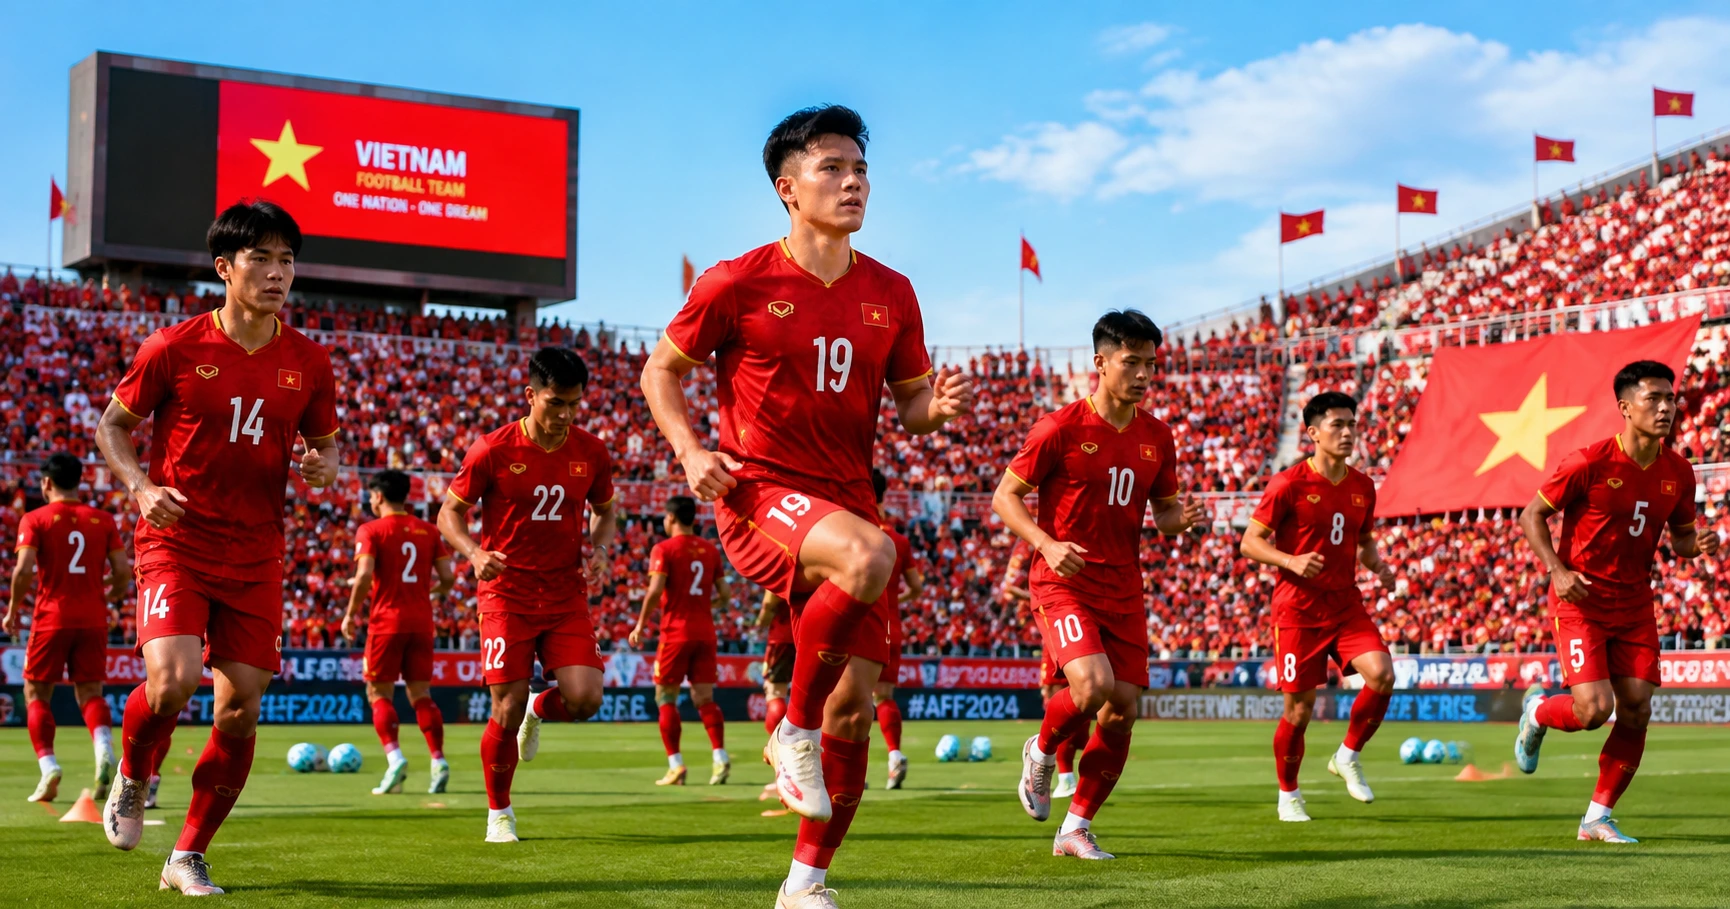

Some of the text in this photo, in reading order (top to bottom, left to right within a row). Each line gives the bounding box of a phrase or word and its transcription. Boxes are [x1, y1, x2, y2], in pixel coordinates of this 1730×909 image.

[355, 139, 467, 178] VIETNAM
[356, 171, 466, 198] FOOTBALL TEAM
[333, 191, 359, 208] ONE
[362, 194, 408, 213] NATION
[418, 200, 442, 217] ONE
[445, 203, 488, 221] DREAM
[813, 336, 853, 393] 19
[229, 396, 264, 445] 14
[531, 484, 565, 521] 22
[1108, 466, 1135, 506] 10
[766, 493, 811, 531] 19
[1330, 512, 1345, 545] 8
[1628, 500, 1649, 537] 5
[68, 530, 86, 574] 2
[401, 541, 418, 583] 2
[689, 560, 704, 596] 2
[143, 583, 170, 627] 14
[1053, 613, 1084, 648] 10
[484, 637, 506, 671] 22
[1283, 652, 1296, 683] 8
[1569, 638, 1585, 669] 5
[908, 694, 1020, 719] #AFF2024
